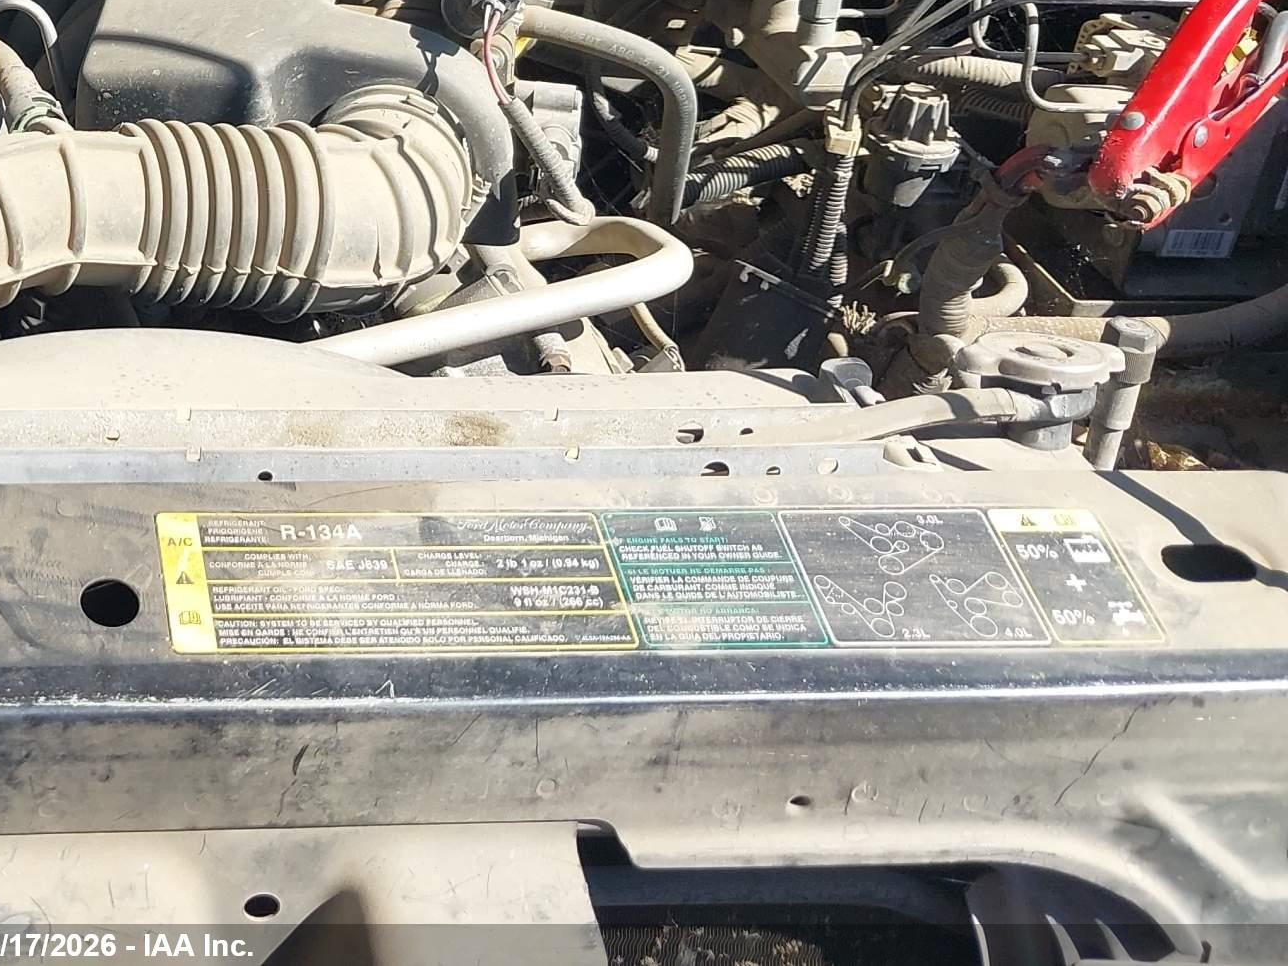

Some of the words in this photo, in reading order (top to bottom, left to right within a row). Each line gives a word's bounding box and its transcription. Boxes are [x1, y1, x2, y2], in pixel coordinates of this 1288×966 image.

[916, 514, 944, 525] 3.0L
[456, 520, 487, 532] Ford
[487, 519, 527, 533] Motor
[279, 524, 363, 542] R-134A
[528, 534, 570, 542] Michigan
[167, 537, 193, 547] A/C
[618, 545, 650, 553] CHECK
[715, 544, 750, 552] SWITCH
[1015, 543, 1059, 560] 50%
[417, 552, 452, 560] CHARGE
[621, 553, 680, 561] REFERENCED
[691, 552, 717, 560] YOUR
[718, 552, 752, 560] OWNER
[326, 559, 355, 571] SAE
[496, 559, 504, 569] 2
[520, 559, 527, 569] 1
[529, 561, 544, 569] oz
[580, 558, 600, 571] kg)
[684, 575, 737, 583] COMMANDE
[737, 575, 751, 583] DE
[751, 575, 795, 583] COUPURE
[212, 586, 270, 594] REFRIGERANT
[272, 586, 287, 594] OIL
[632, 584, 646, 592] DE
[704, 583, 739, 591] COMME
[213, 594, 262, 602] LUBRIFIANT
[372, 593, 396, 601] FORD
[635, 592, 661, 600] DANS
[675, 591, 704, 599] GUIDE
[704, 591, 718, 599] DE
[233, 602, 264, 611] ACEITE
[361, 602, 409, 610] CONFORME
[410, 602, 418, 610] A
[418, 601, 450, 610] NORMA
[534, 598, 550, 607] oz
[584, 597, 604, 609] cc)
[295, 619, 308, 627] TO
[322, 619, 366, 627] SERVICED
[379, 618, 425, 626] QUALIFIED
[755, 615, 770, 623] DE
[771, 615, 805, 623] CIERRE
[1051, 609, 1096, 626] 50%
[217, 628, 240, 636] MISE
[240, 628, 254, 636] EN
[255, 628, 285, 636] GARDE
[435, 626, 488, 634] PERSONNEL
[647, 624, 665, 632] DEL
[732, 624, 761, 632] COMO
[775, 623, 807, 631] INDICA
[1004, 627, 1033, 638] 4.0L
[648, 633, 663, 641] EN
[664, 633, 679, 641] LA
[702, 632, 721, 640] DEL
[901, 627, 931, 639] 2.3L
[282, 637, 295, 645] EL
[295, 637, 334, 645] SISTEMA
[378, 636, 422, 644] ATENDIDO
[447, 635, 467, 643] POR
[468, 635, 513, 643] PERSONAL
